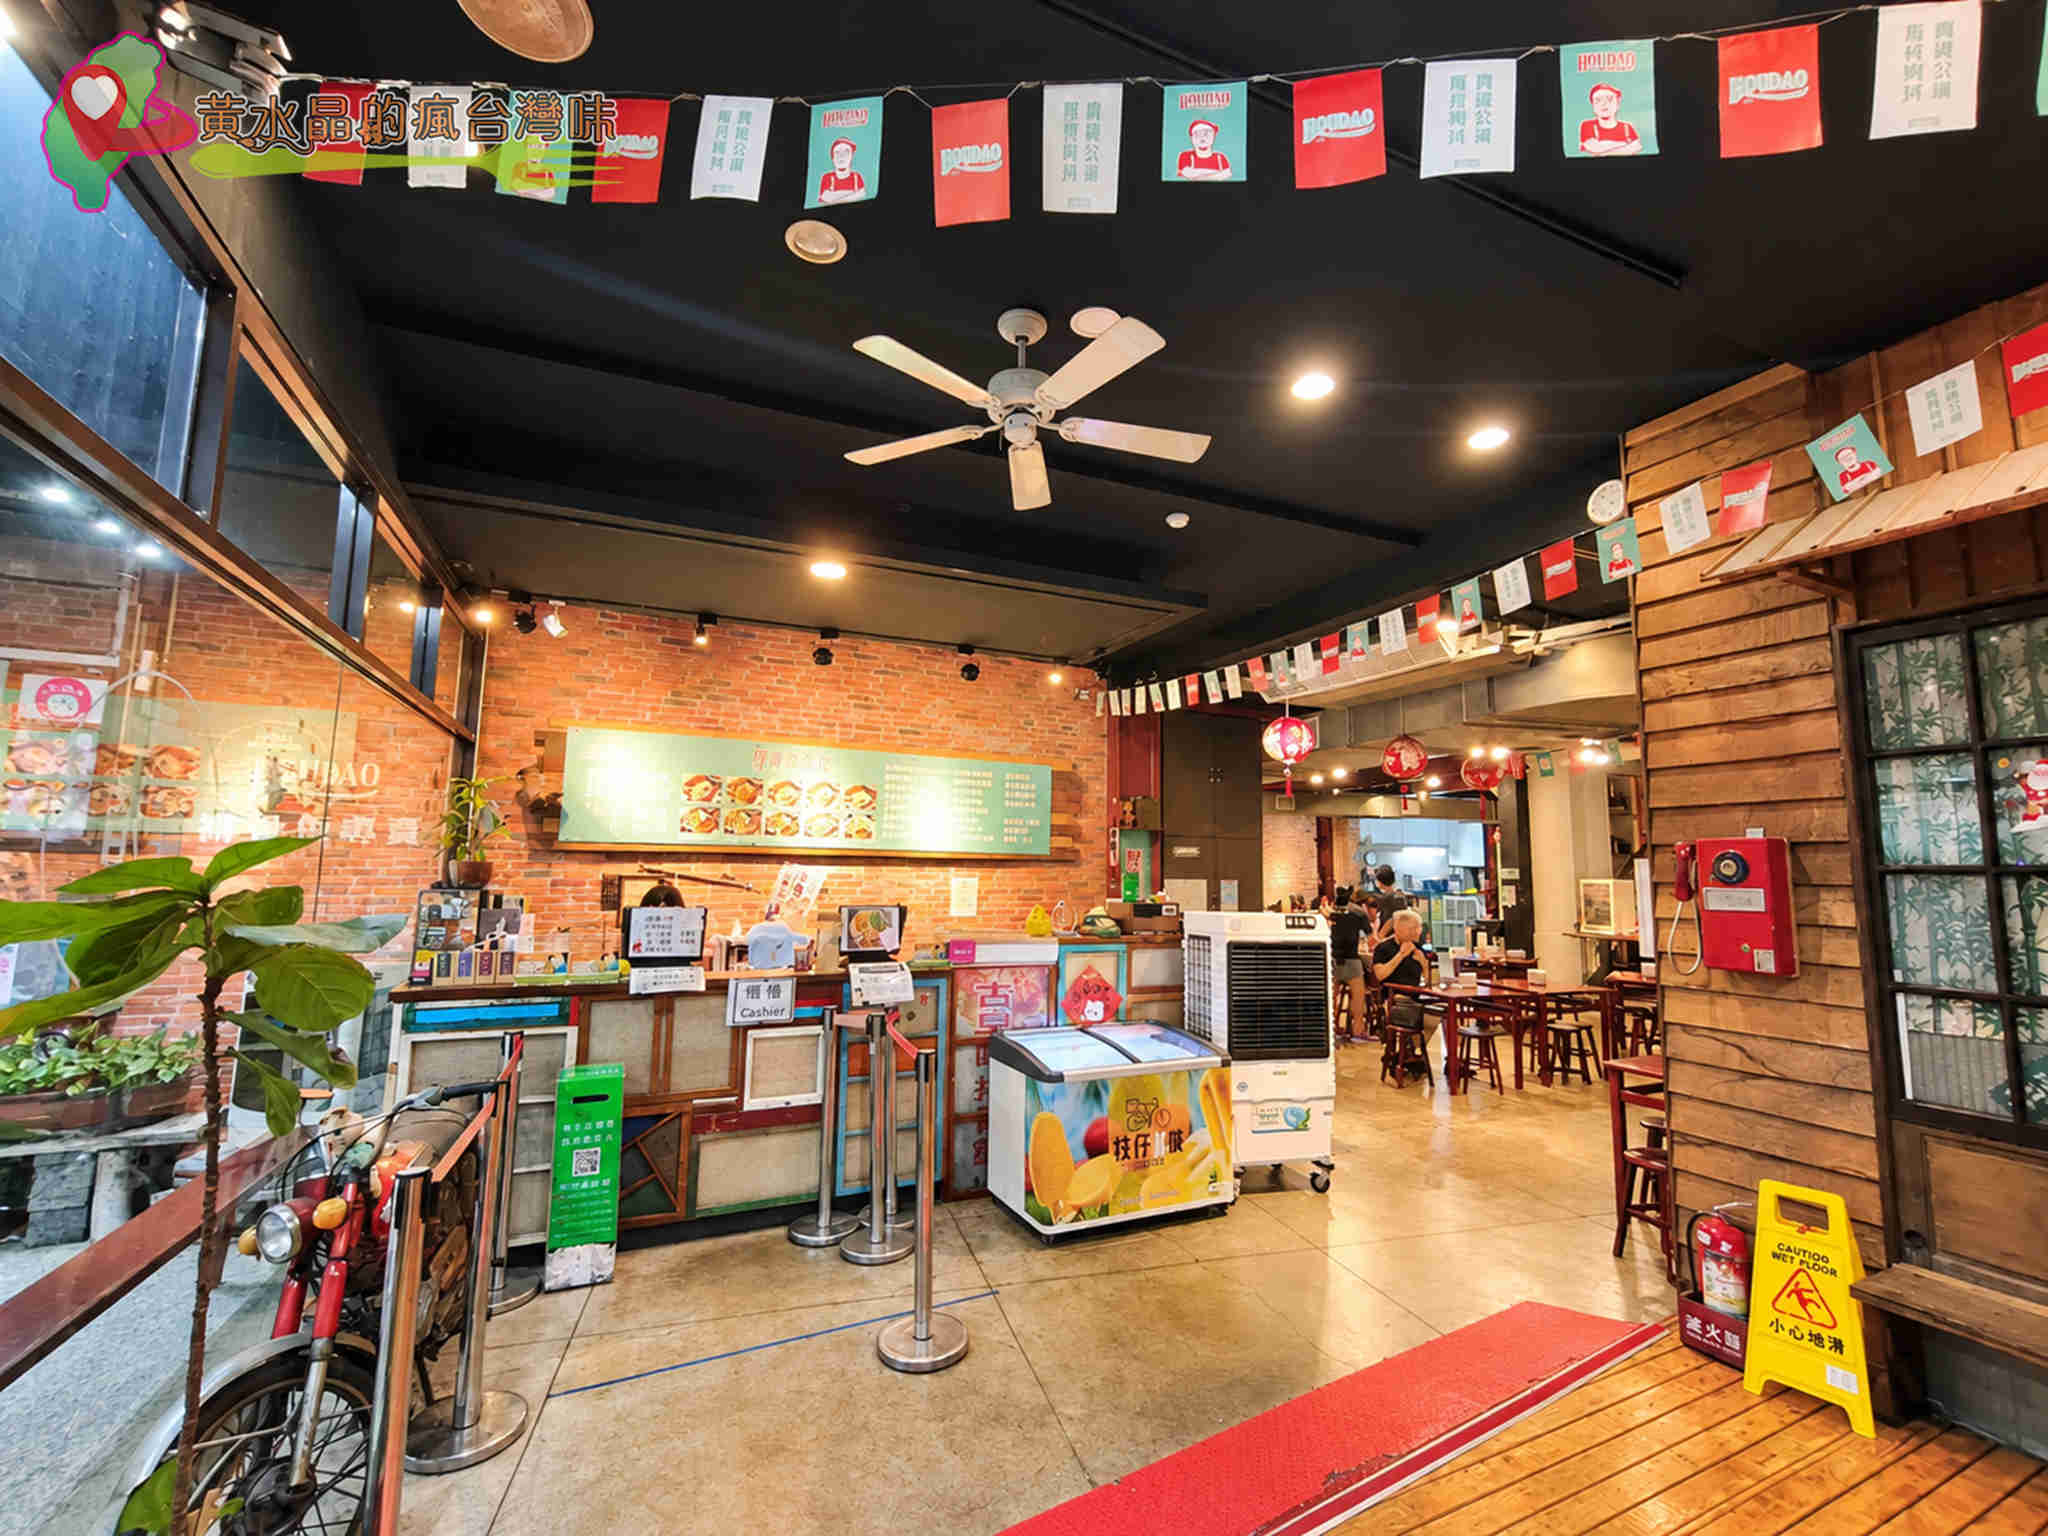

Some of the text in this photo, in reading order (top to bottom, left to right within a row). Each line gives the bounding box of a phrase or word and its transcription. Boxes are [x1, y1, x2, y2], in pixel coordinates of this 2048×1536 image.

[1576, 50, 1637, 72] HOUDAO
[1728, 68, 1809, 104] HOUDAO
[1302, 107, 1375, 144] HOUDAO
[740, 1006, 786, 1018] Cashier
[1771, 1251, 1838, 1277] WET FLOOR
[1769, 1318, 1845, 1355] 小心地滑
